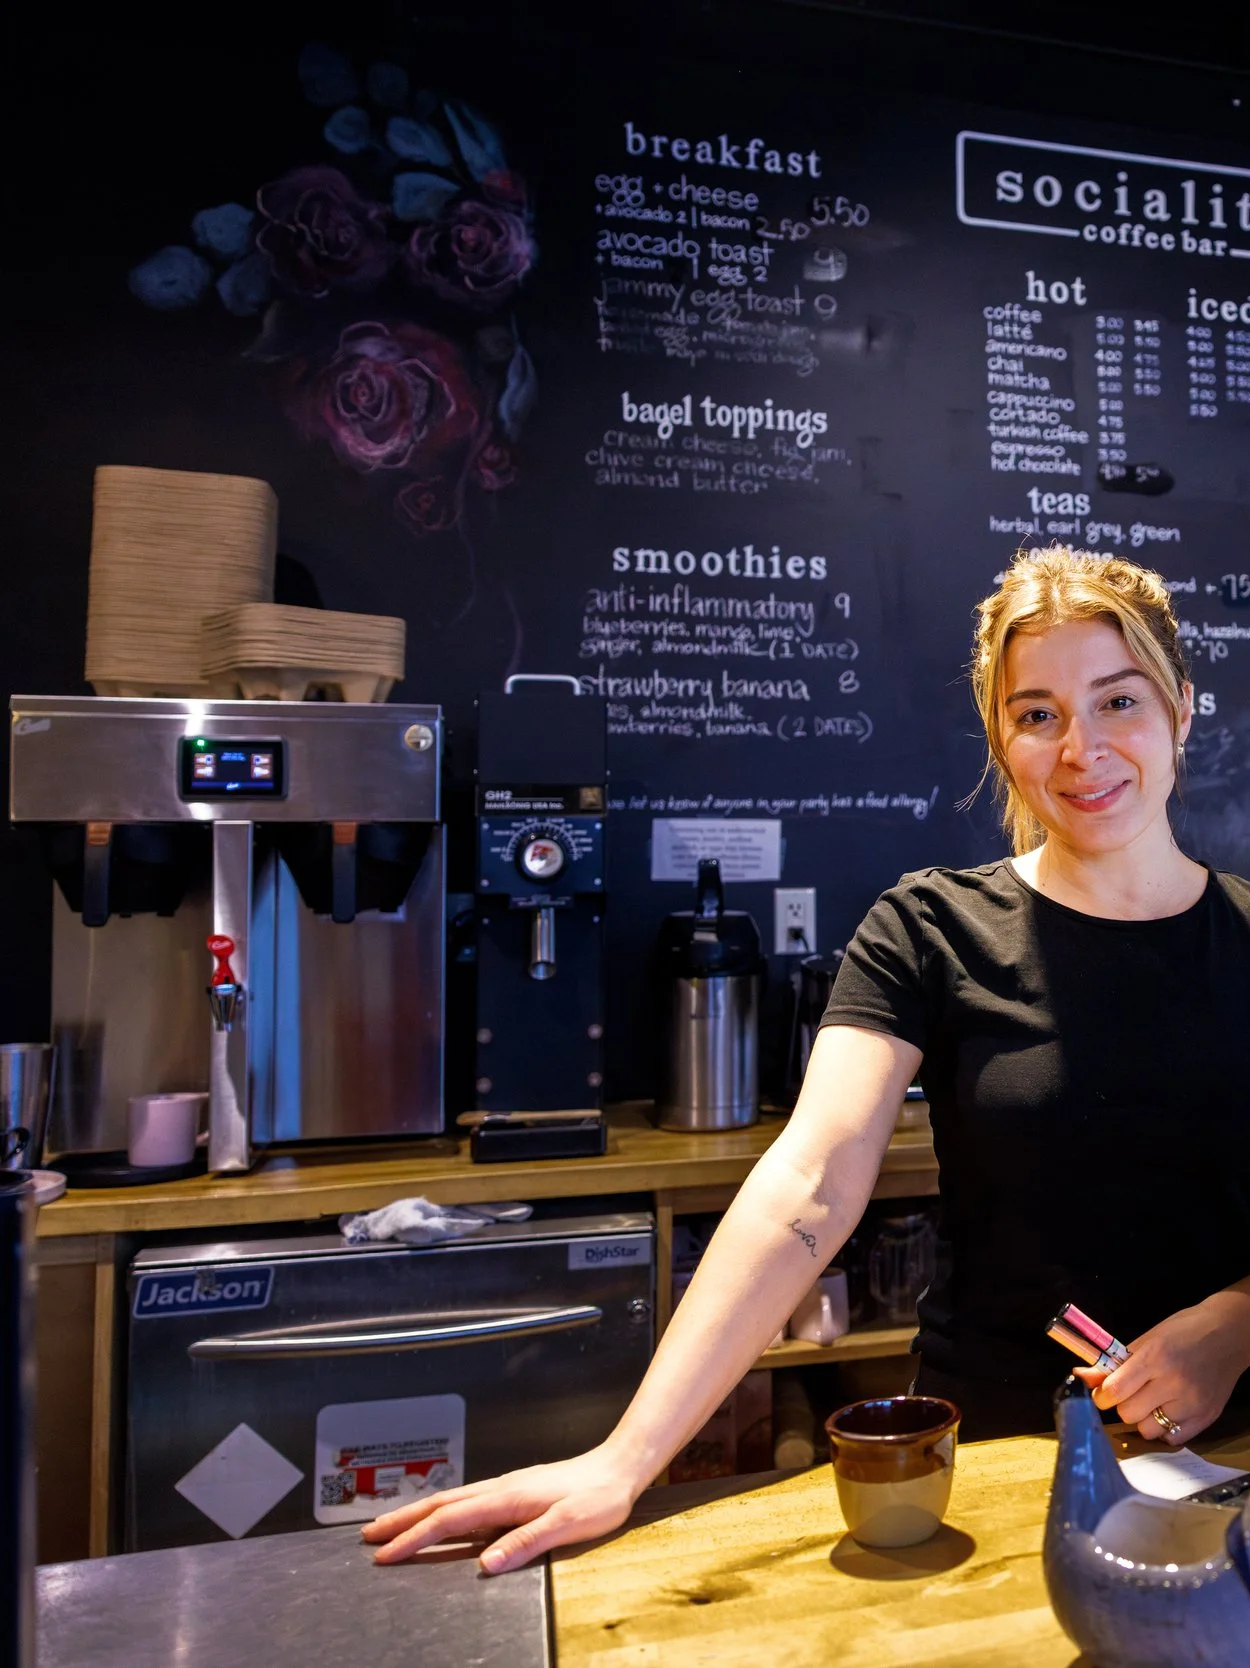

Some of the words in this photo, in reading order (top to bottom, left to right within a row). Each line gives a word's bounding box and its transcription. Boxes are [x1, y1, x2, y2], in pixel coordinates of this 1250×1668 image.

[624, 120, 823, 179] breakfast
[594, 174, 645, 208] egg
[668, 173, 760, 212] cheese
[810, 196, 870, 228] 5.50
[604, 205, 674, 224] avocado
[676, 212, 687, 224] 2
[700, 211, 751, 231] bacon
[597, 229, 701, 259] avocado
[709, 237, 775, 265] toast
[1082, 223, 1176, 251] coffee
[1180, 228, 1228, 258] bar
[611, 252, 664, 271] bacon
[707, 263, 748, 287] egg
[753, 266, 768, 283] 2
[1025, 269, 1088, 307] hot
[690, 289, 742, 325] egg
[738, 284, 805, 317] toast
[813, 294, 838, 321] 9
[983, 302, 1043, 324] coffee
[984, 338, 1068, 361] americano
[987, 354, 1024, 373] chai
[987, 372, 1051, 391] matcha
[621, 390, 694, 440] bagel
[699, 395, 829, 449] toppings
[988, 407, 1061, 425] cortado
[1042, 423, 1090, 444] coffee
[584, 447, 645, 468] chive
[654, 454, 726, 474] cream
[595, 465, 681, 489] almond
[692, 471, 768, 495] butter
[1026, 486, 1092, 516] teas
[1129, 521, 1182, 548] green
[612, 544, 828, 580] smoothies
[584, 582, 816, 638] anti-inflammatory
[834, 592, 851, 619] 9
[577, 662, 715, 714] strawberry
[721, 669, 812, 702] banana
[837, 669, 862, 695] 8
[705, 720, 773, 738] banana
[142, 1279, 262, 1308] Jackson
